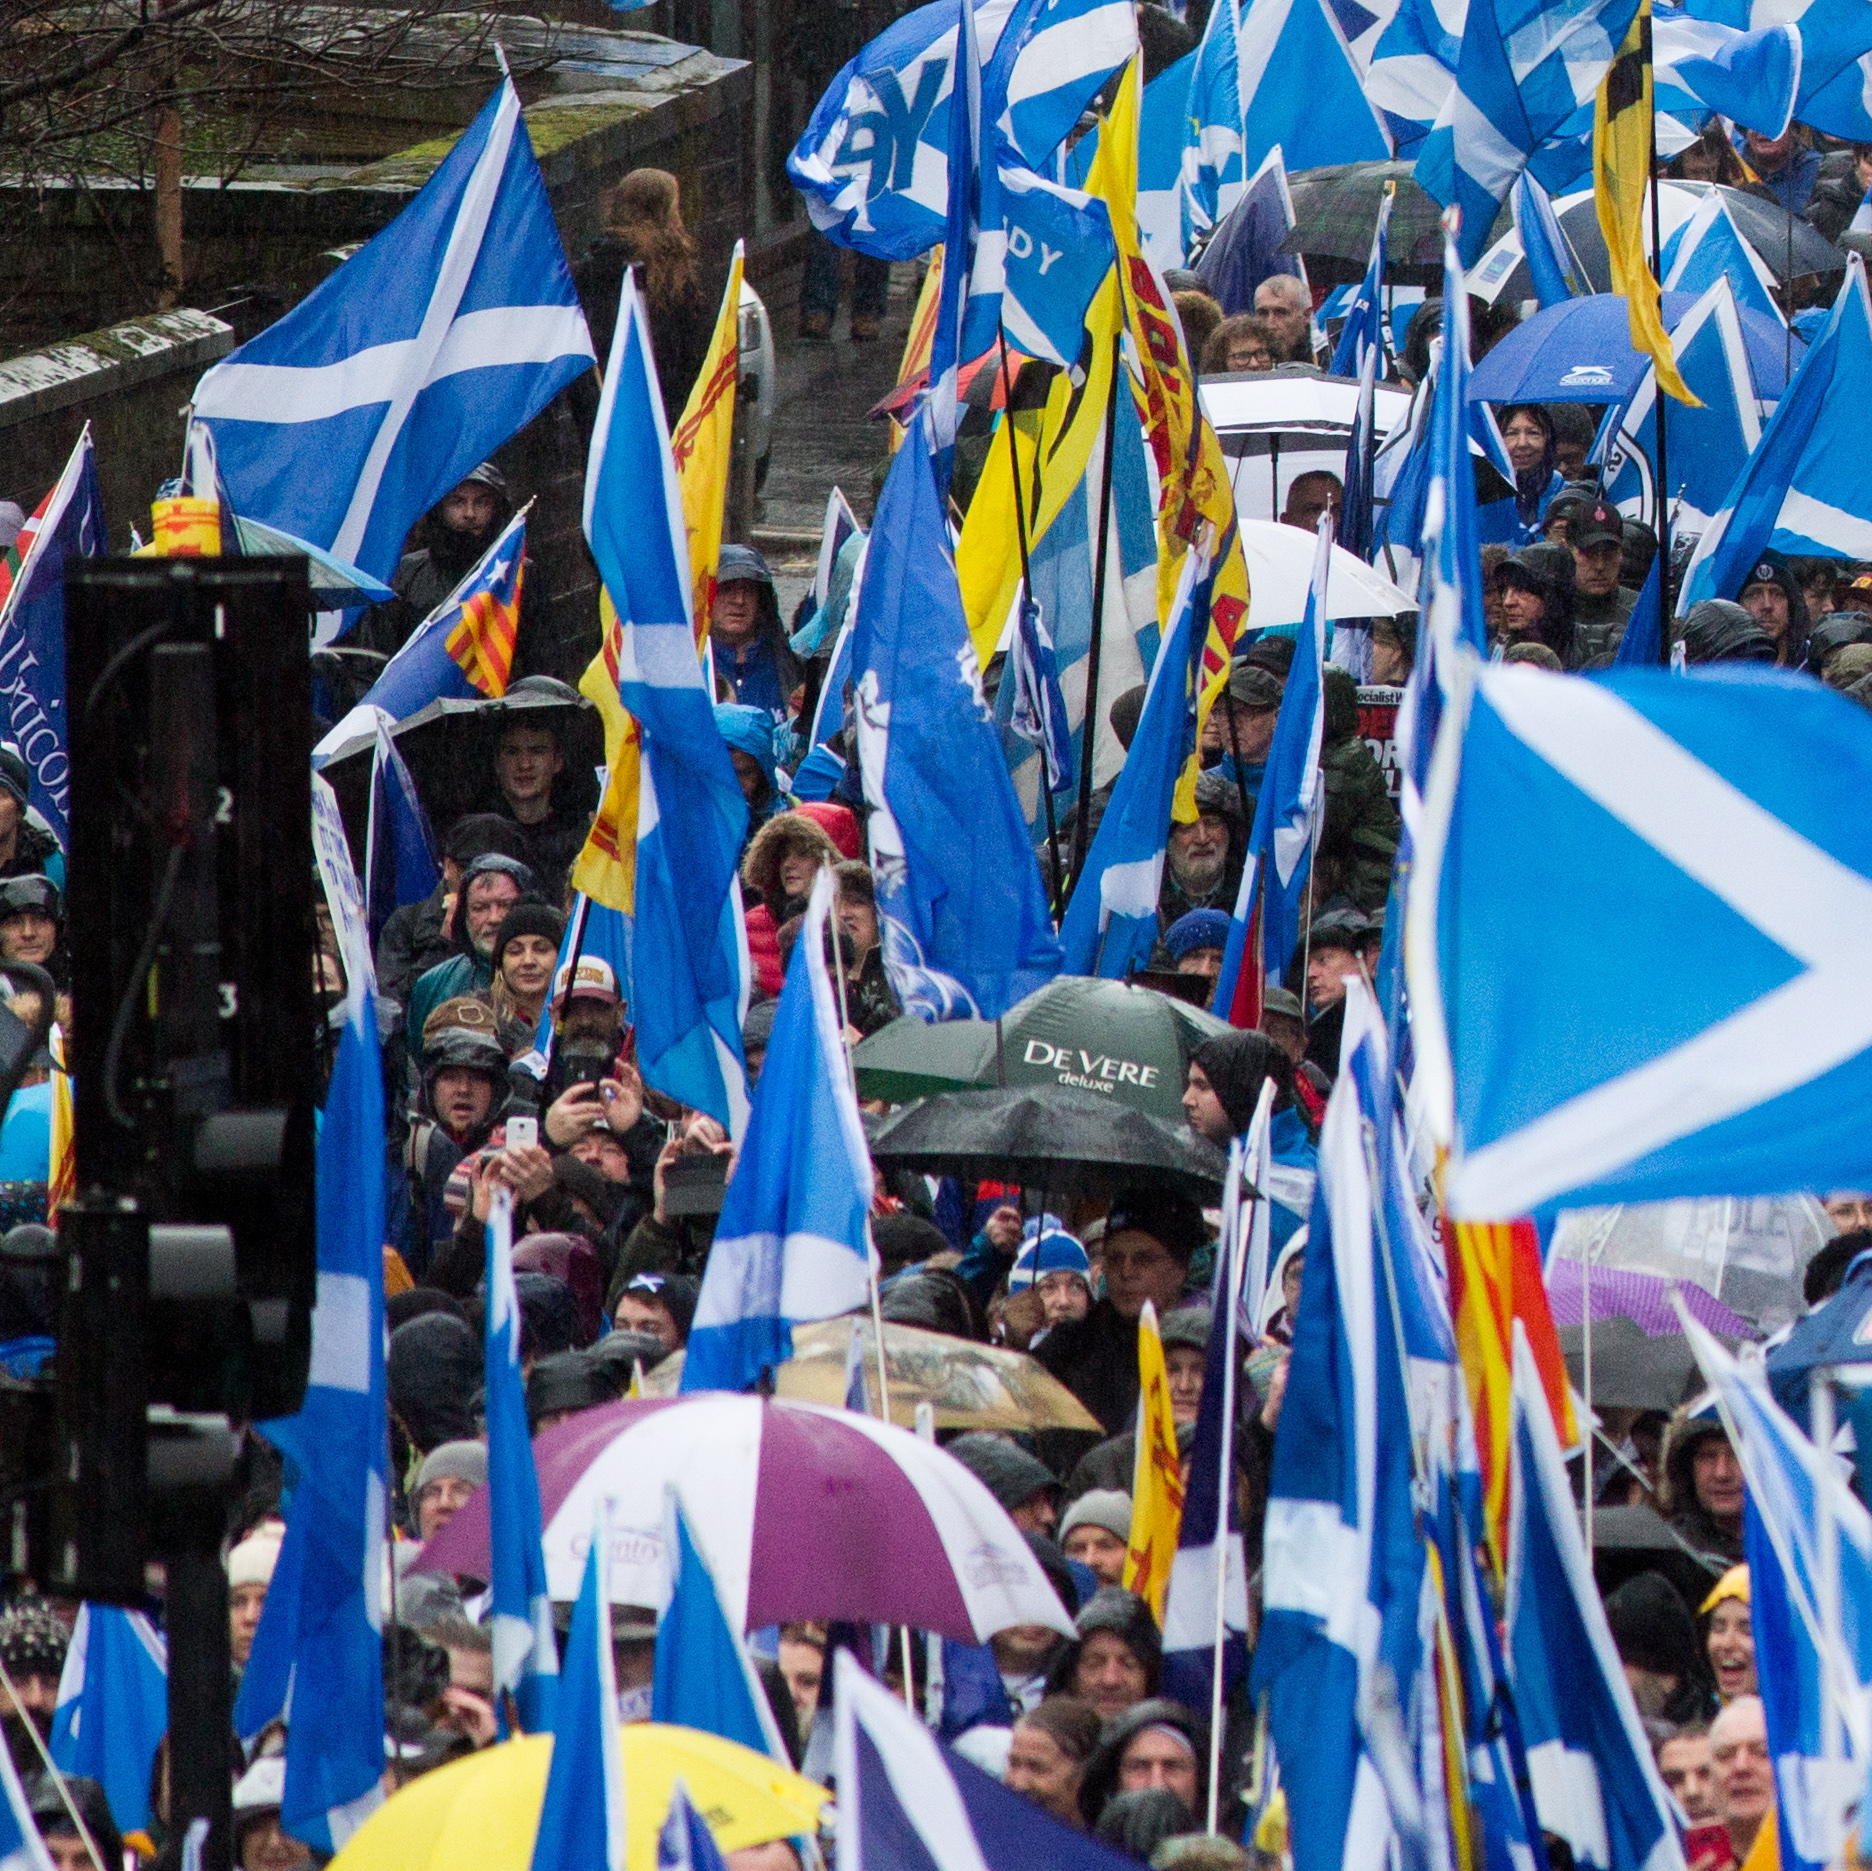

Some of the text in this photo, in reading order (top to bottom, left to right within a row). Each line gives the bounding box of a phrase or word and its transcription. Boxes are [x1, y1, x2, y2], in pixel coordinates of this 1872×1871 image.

[1024, 1039, 1160, 1088] DE VERE
[1058, 1071, 1114, 1094] deluxe
